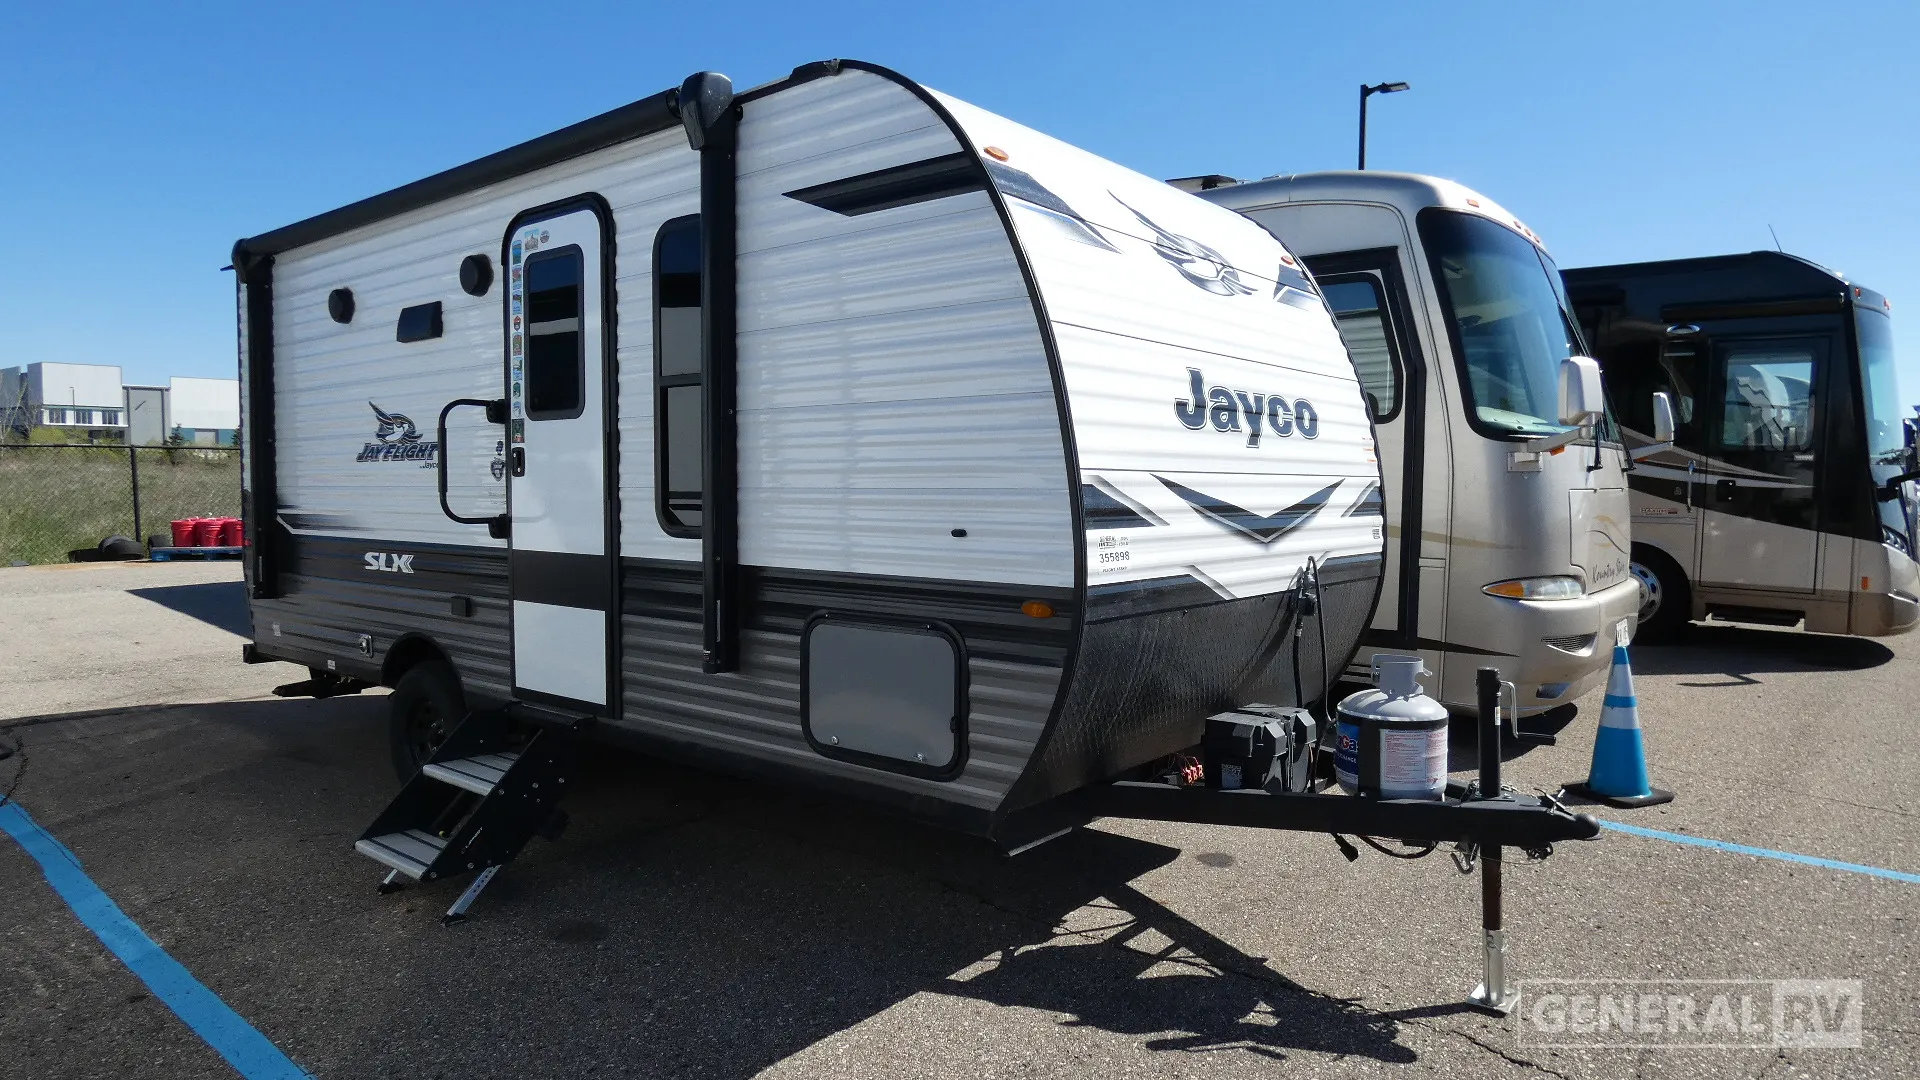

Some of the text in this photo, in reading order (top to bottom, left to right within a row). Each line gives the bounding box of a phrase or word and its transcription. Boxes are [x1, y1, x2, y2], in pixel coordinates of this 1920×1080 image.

[1174, 366, 1320, 449] Jayco
[364, 551, 415, 574] SLX
[1099, 551, 1130, 564] 355898
